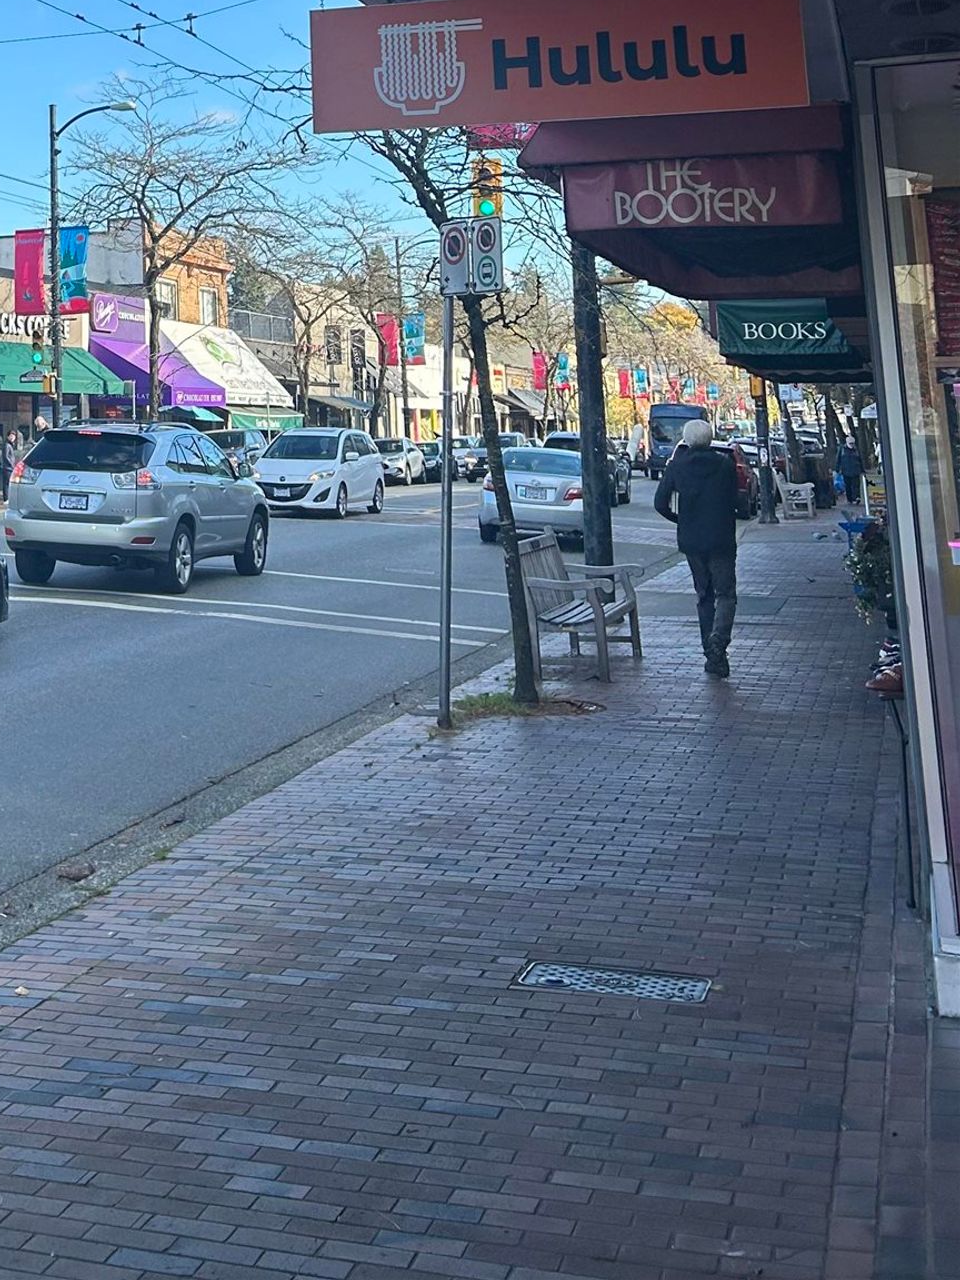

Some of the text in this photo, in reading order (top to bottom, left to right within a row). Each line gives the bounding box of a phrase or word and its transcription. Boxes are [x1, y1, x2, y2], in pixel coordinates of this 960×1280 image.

[491, 25, 747, 91] Hululu
[646, 158, 711, 191] THE
[614, 185, 776, 225] BOOTERY
[742, 322, 827, 340] BOOKS
